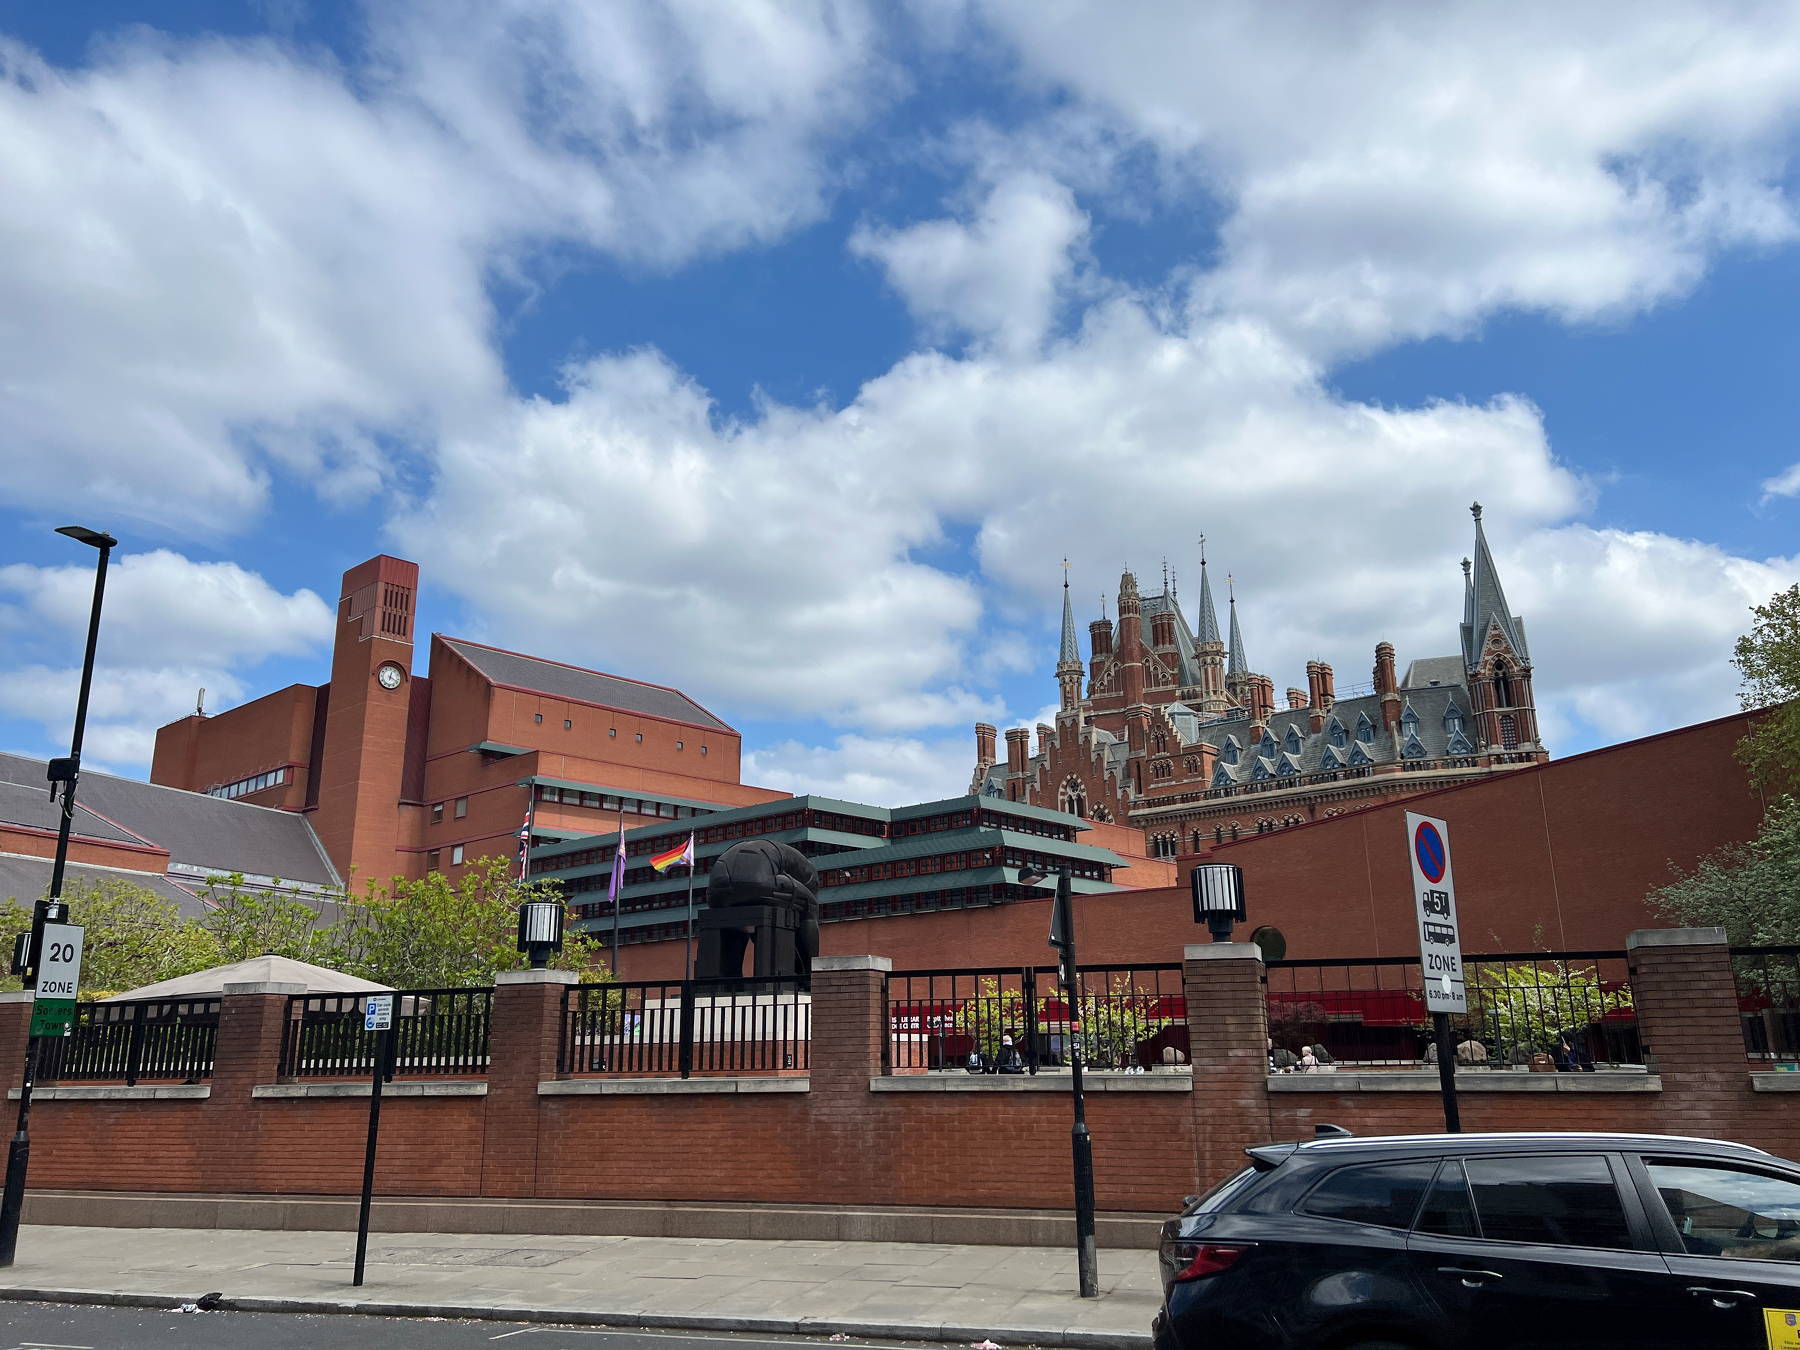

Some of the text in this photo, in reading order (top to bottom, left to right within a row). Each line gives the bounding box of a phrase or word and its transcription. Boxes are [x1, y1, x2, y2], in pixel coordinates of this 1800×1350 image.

[1433, 892, 1446, 911] 5T
[49, 942, 74, 963] 20
[1428, 954, 1457, 972] ZONE
[41, 981, 73, 994] ZONE
[1429, 989, 1441, 999] 6.30
